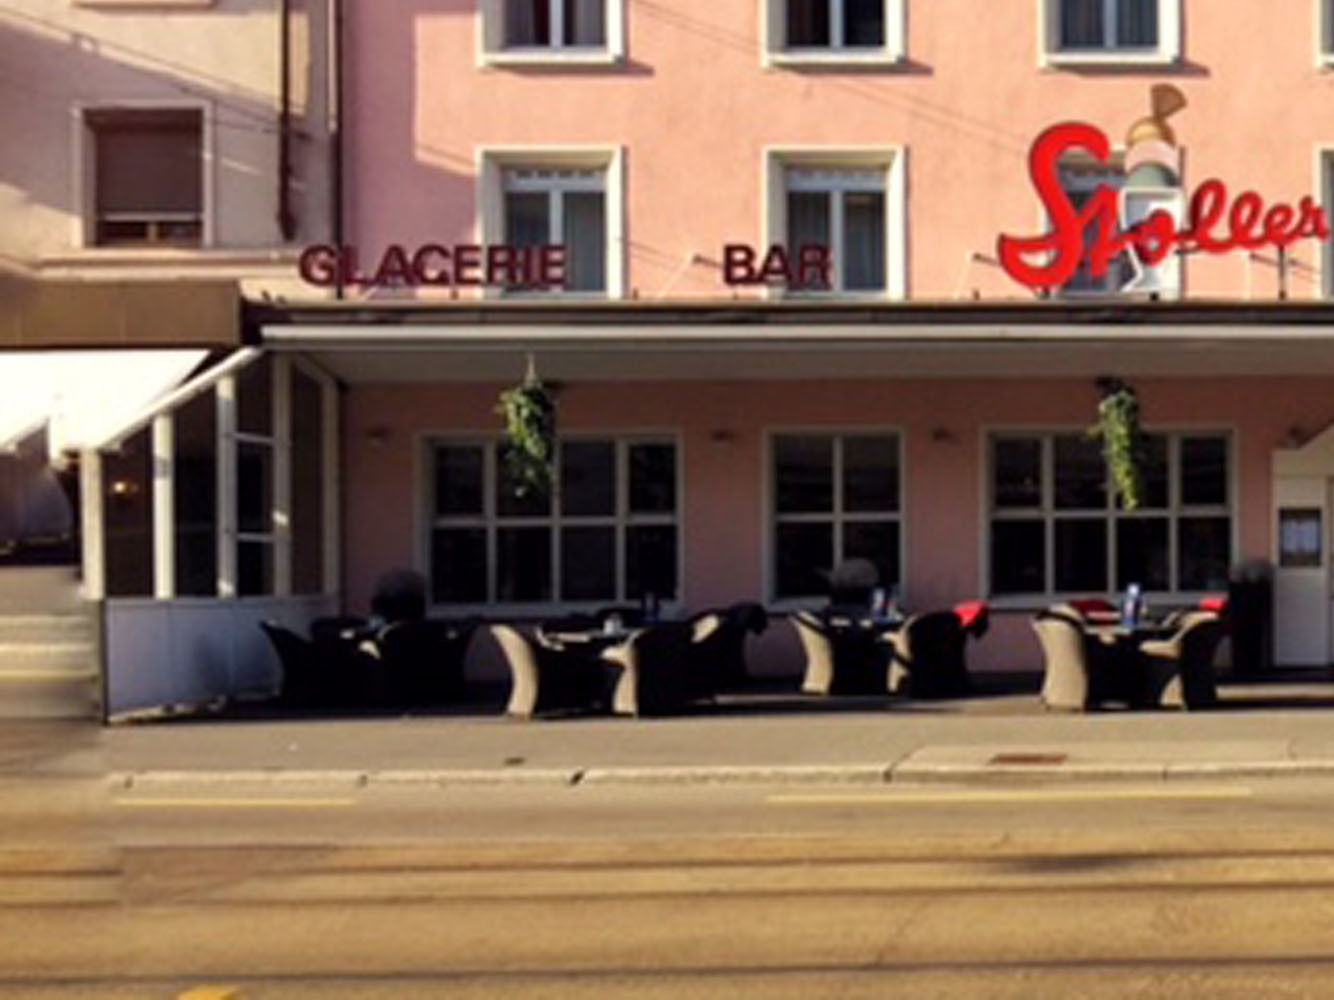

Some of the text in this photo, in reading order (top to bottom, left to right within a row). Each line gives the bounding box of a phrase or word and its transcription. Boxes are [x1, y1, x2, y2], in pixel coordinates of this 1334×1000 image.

[996, 121, 1331, 288] Stoller
[298, 244, 831, 287] GLACERIE BAR
